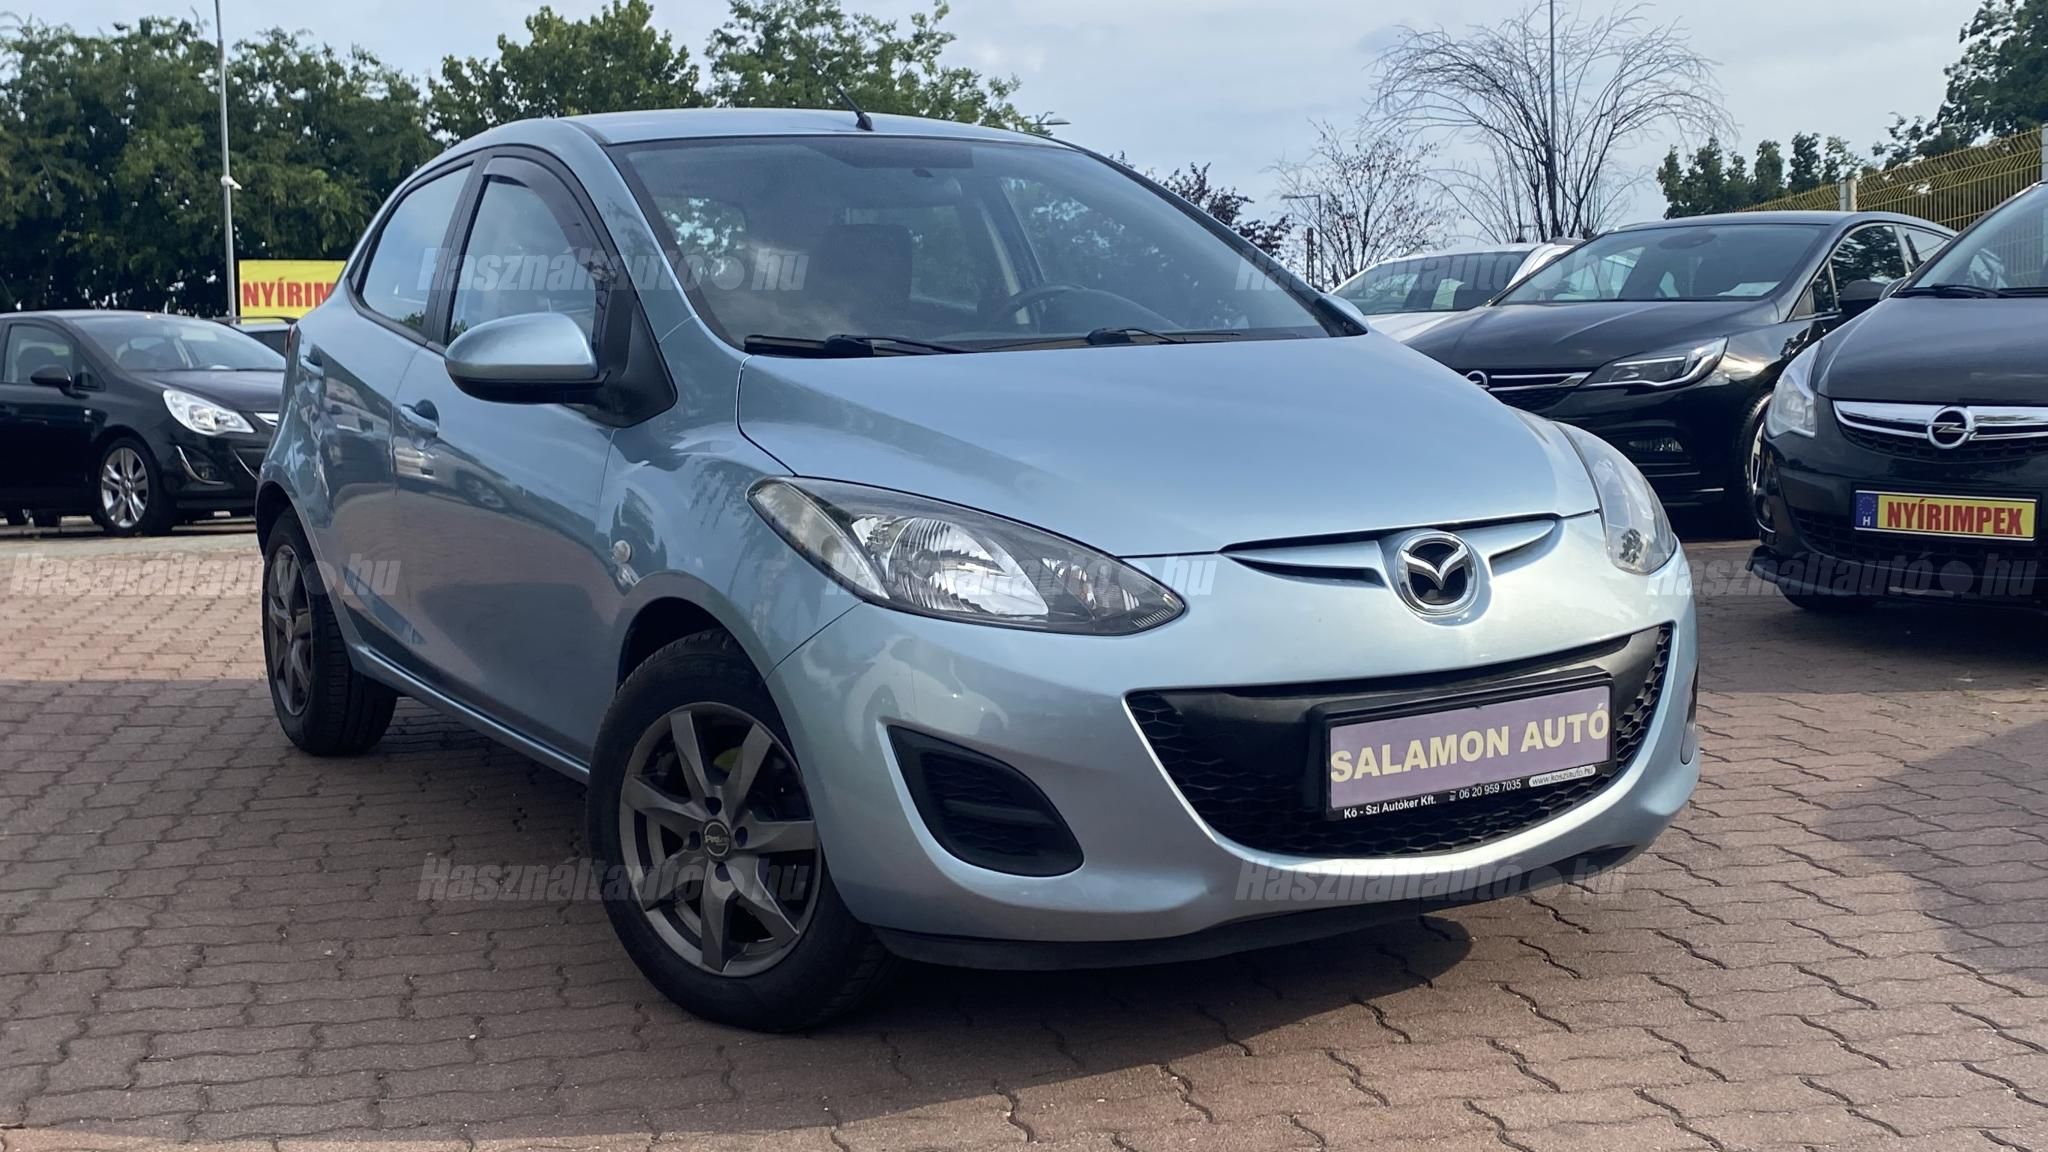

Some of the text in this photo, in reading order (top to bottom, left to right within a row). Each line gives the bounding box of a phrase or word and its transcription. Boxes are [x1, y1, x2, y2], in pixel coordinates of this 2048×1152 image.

[1863, 516, 1871, 526] H
[1887, 499, 2023, 535] NYÍRIMPEX
[1331, 703, 1610, 782] SALAMON AUTÓ
[1366, 804, 1380, 815] Szi
[1420, 795, 1437, 807] Kft.
[1459, 789, 1470, 800] 06
[1472, 787, 1483, 797] 20
[1484, 783, 1500, 795] 959
[1502, 779, 1522, 790] 7035
